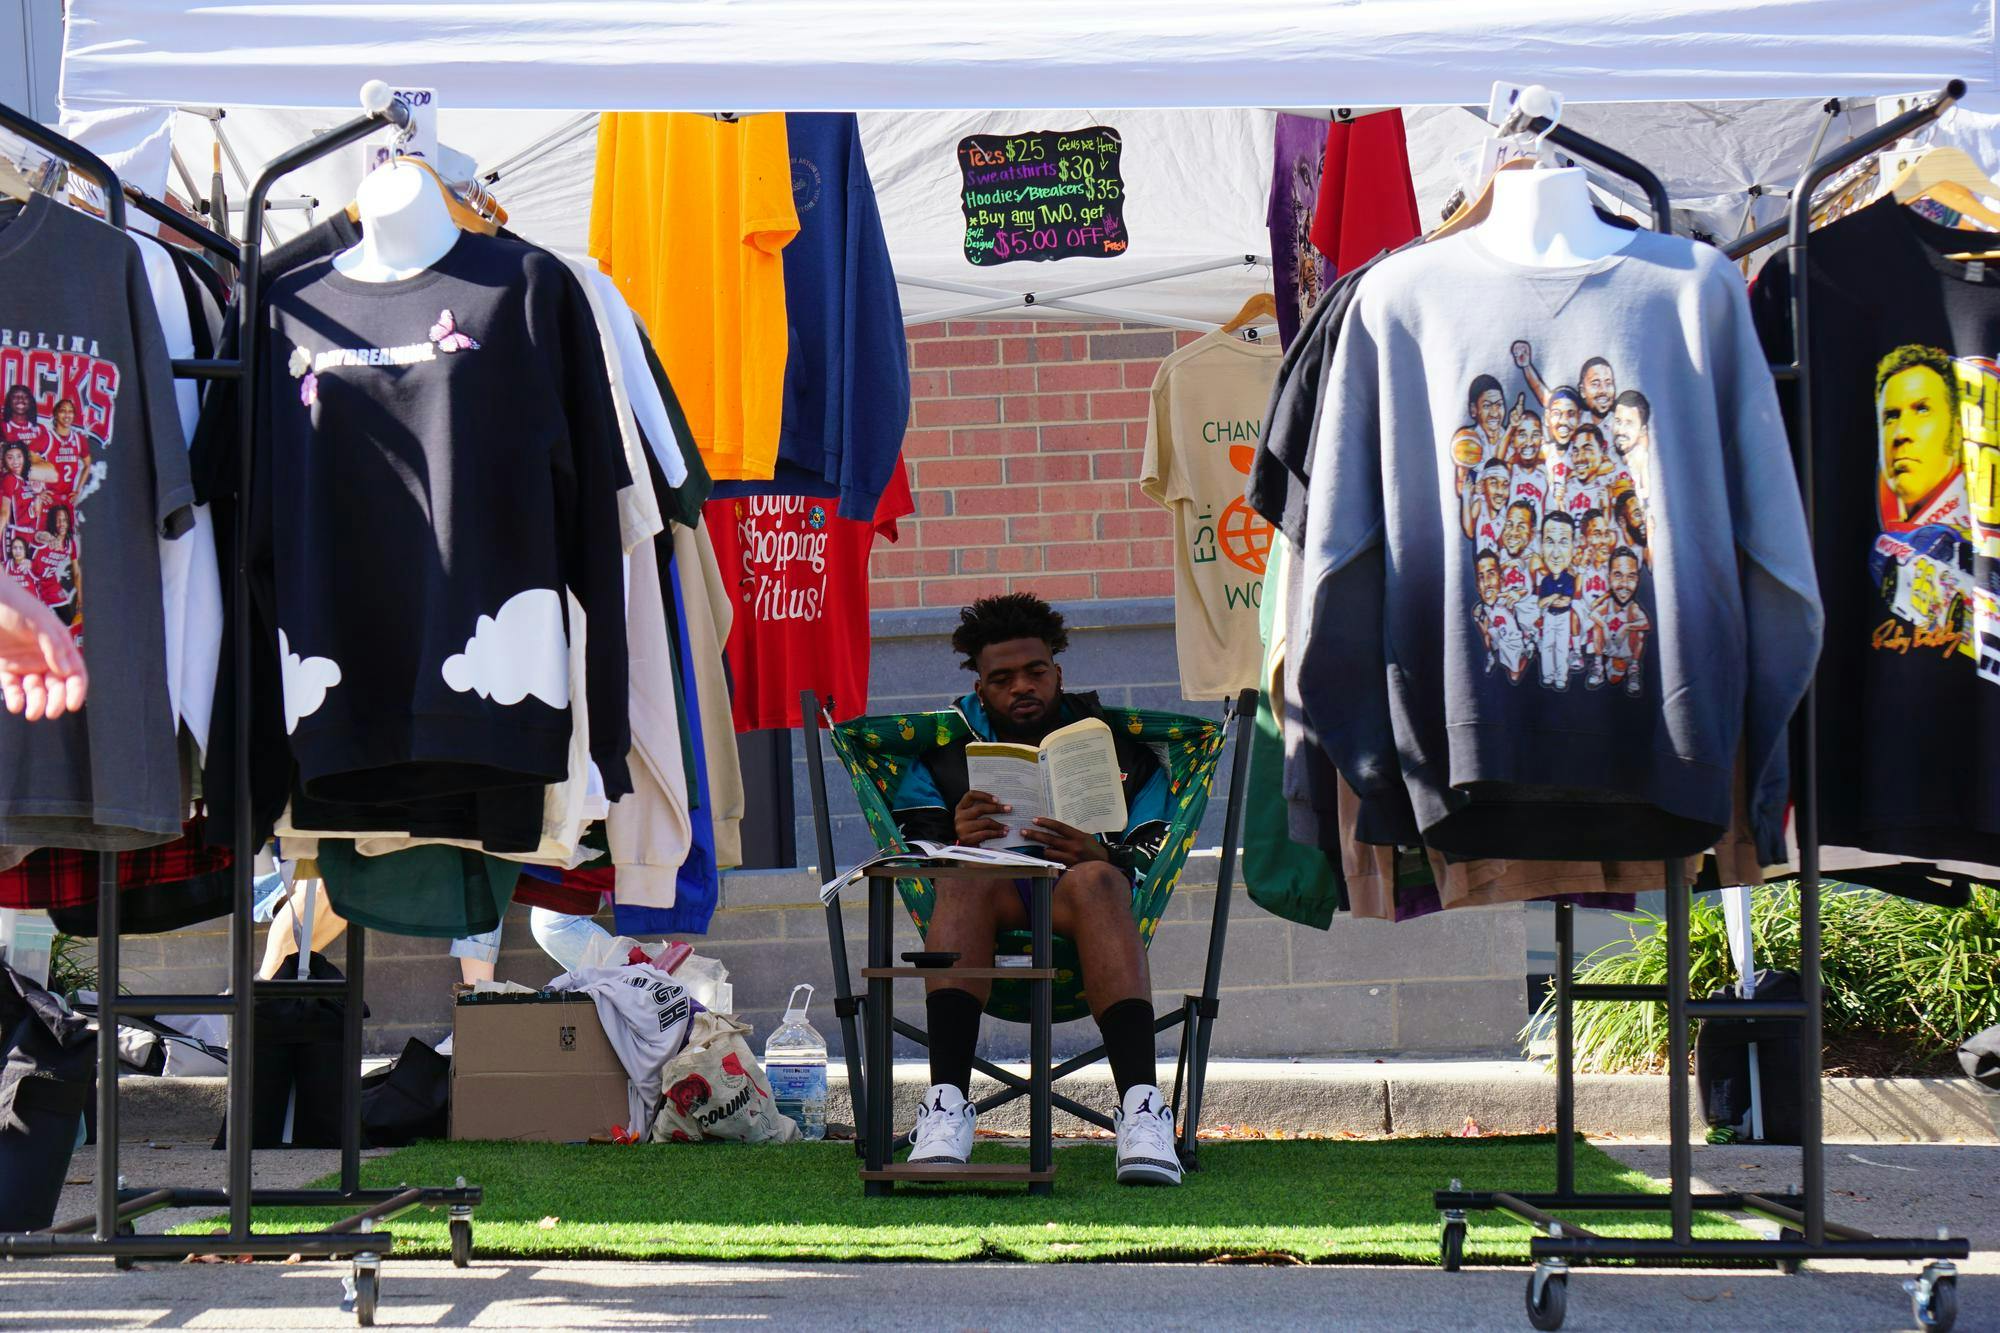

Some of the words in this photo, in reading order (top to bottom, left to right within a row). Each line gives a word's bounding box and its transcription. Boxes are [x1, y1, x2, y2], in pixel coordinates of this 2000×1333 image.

[969, 148, 1006, 167] Tees
[1005, 139, 1045, 162] $25
[966, 162, 1057, 187] Sweatshirts
[1058, 155, 1094, 182] $30
[1084, 176, 1120, 201] $35
[1011, 209, 1036, 233] any
[1080, 204, 1105, 227] get
[993, 228, 1058, 260] $5.00
[1066, 226, 1105, 247] OFF
[63, 464, 72, 483] 2
